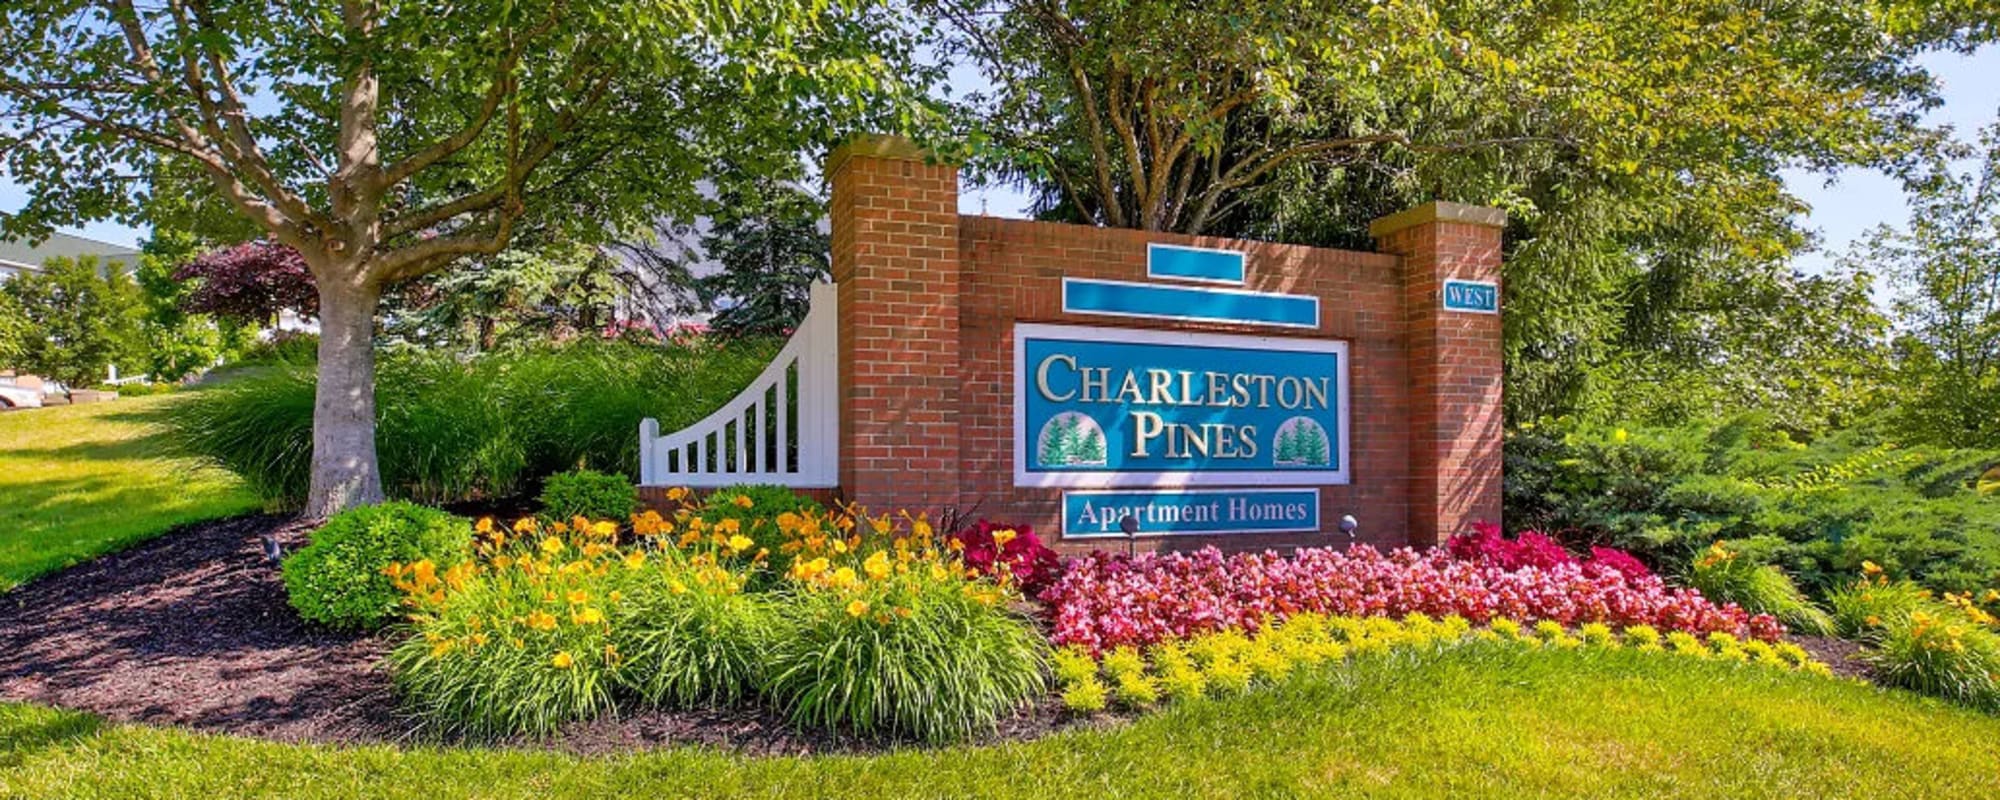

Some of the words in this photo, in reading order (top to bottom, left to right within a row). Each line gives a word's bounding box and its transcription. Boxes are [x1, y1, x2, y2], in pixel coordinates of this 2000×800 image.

[1448, 286, 1493, 307] WEST
[1036, 353, 1330, 410] CHARLESTON
[1131, 410, 1258, 459] PINES
[1077, 499, 1220, 531] Apartment
[1228, 497, 1307, 522] Homes
